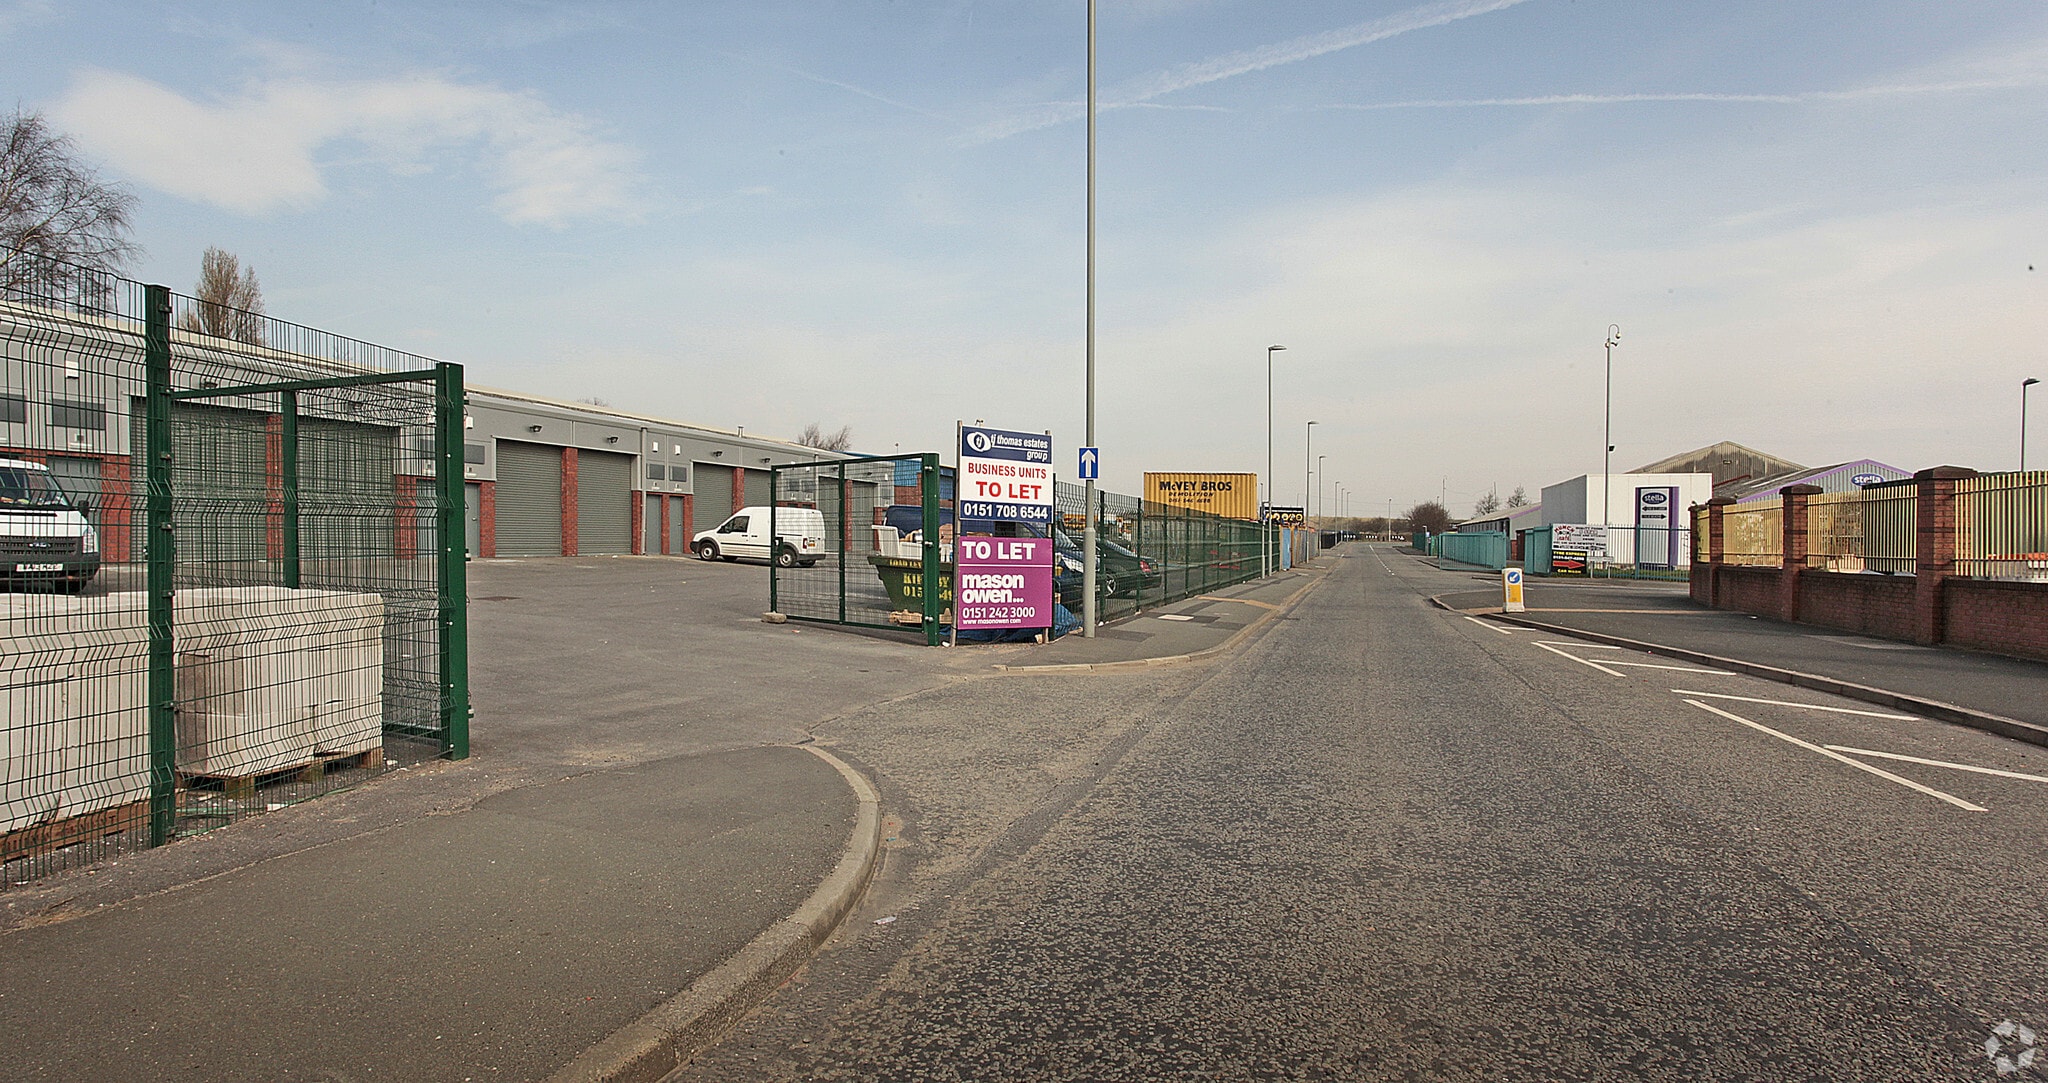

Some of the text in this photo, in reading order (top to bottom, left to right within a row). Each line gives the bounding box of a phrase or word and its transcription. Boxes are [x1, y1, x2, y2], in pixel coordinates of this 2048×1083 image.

[991, 434, 1048, 449] tj thomas estates
[1026, 451, 1048, 462] group
[968, 462, 1047, 480] BUSINESS UNITS
[976, 481, 1042, 500] TO LET
[1160, 481, 1232, 491] McVEY BROS
[964, 502, 1048, 519] 0151 708 6544
[962, 541, 1036, 560] TO LET
[962, 574, 1025, 589] mason
[962, 606, 1036, 618] 0151 242 3000
